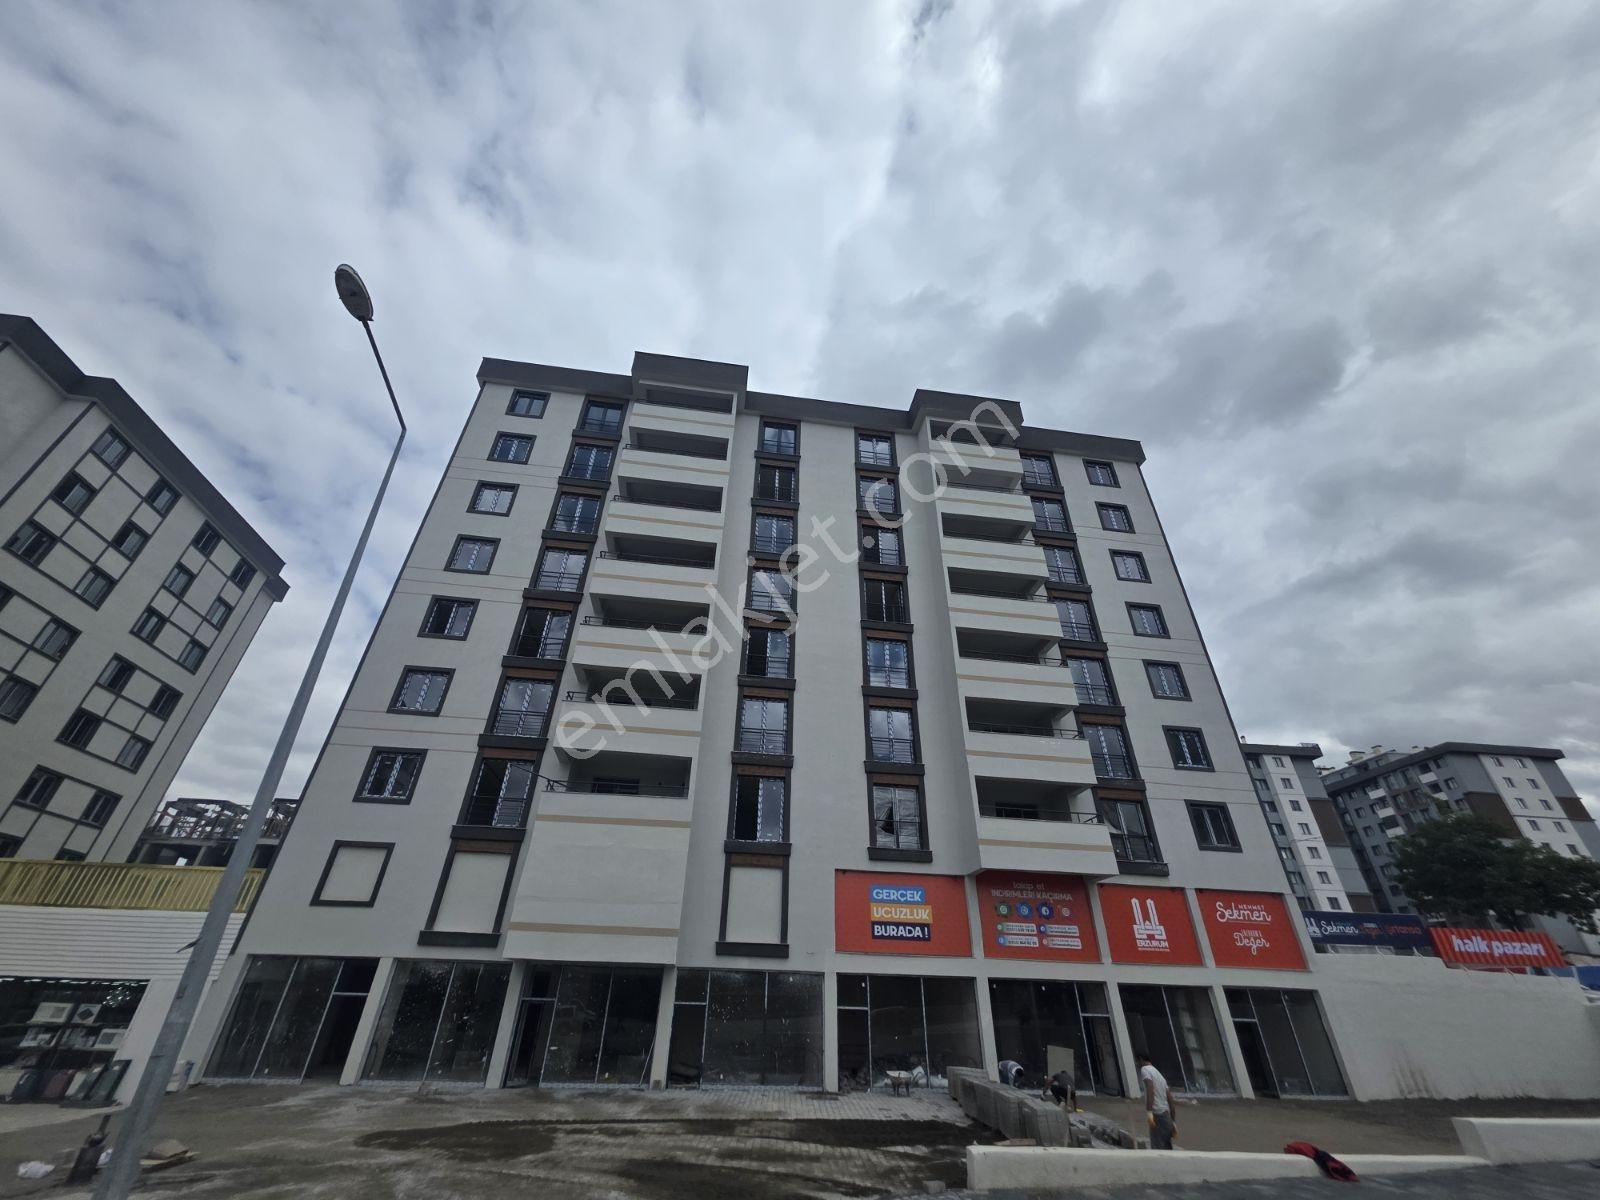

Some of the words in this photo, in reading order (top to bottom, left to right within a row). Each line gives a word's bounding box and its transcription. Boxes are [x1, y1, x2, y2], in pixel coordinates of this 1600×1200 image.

[872, 889, 922, 902] GERÇEK
[873, 907, 930, 920] UCUZLUK
[1216, 901, 1271, 922] Sekmen
[1136, 939, 1169, 948] ERZURUM
[1451, 934, 1490, 953] halk
